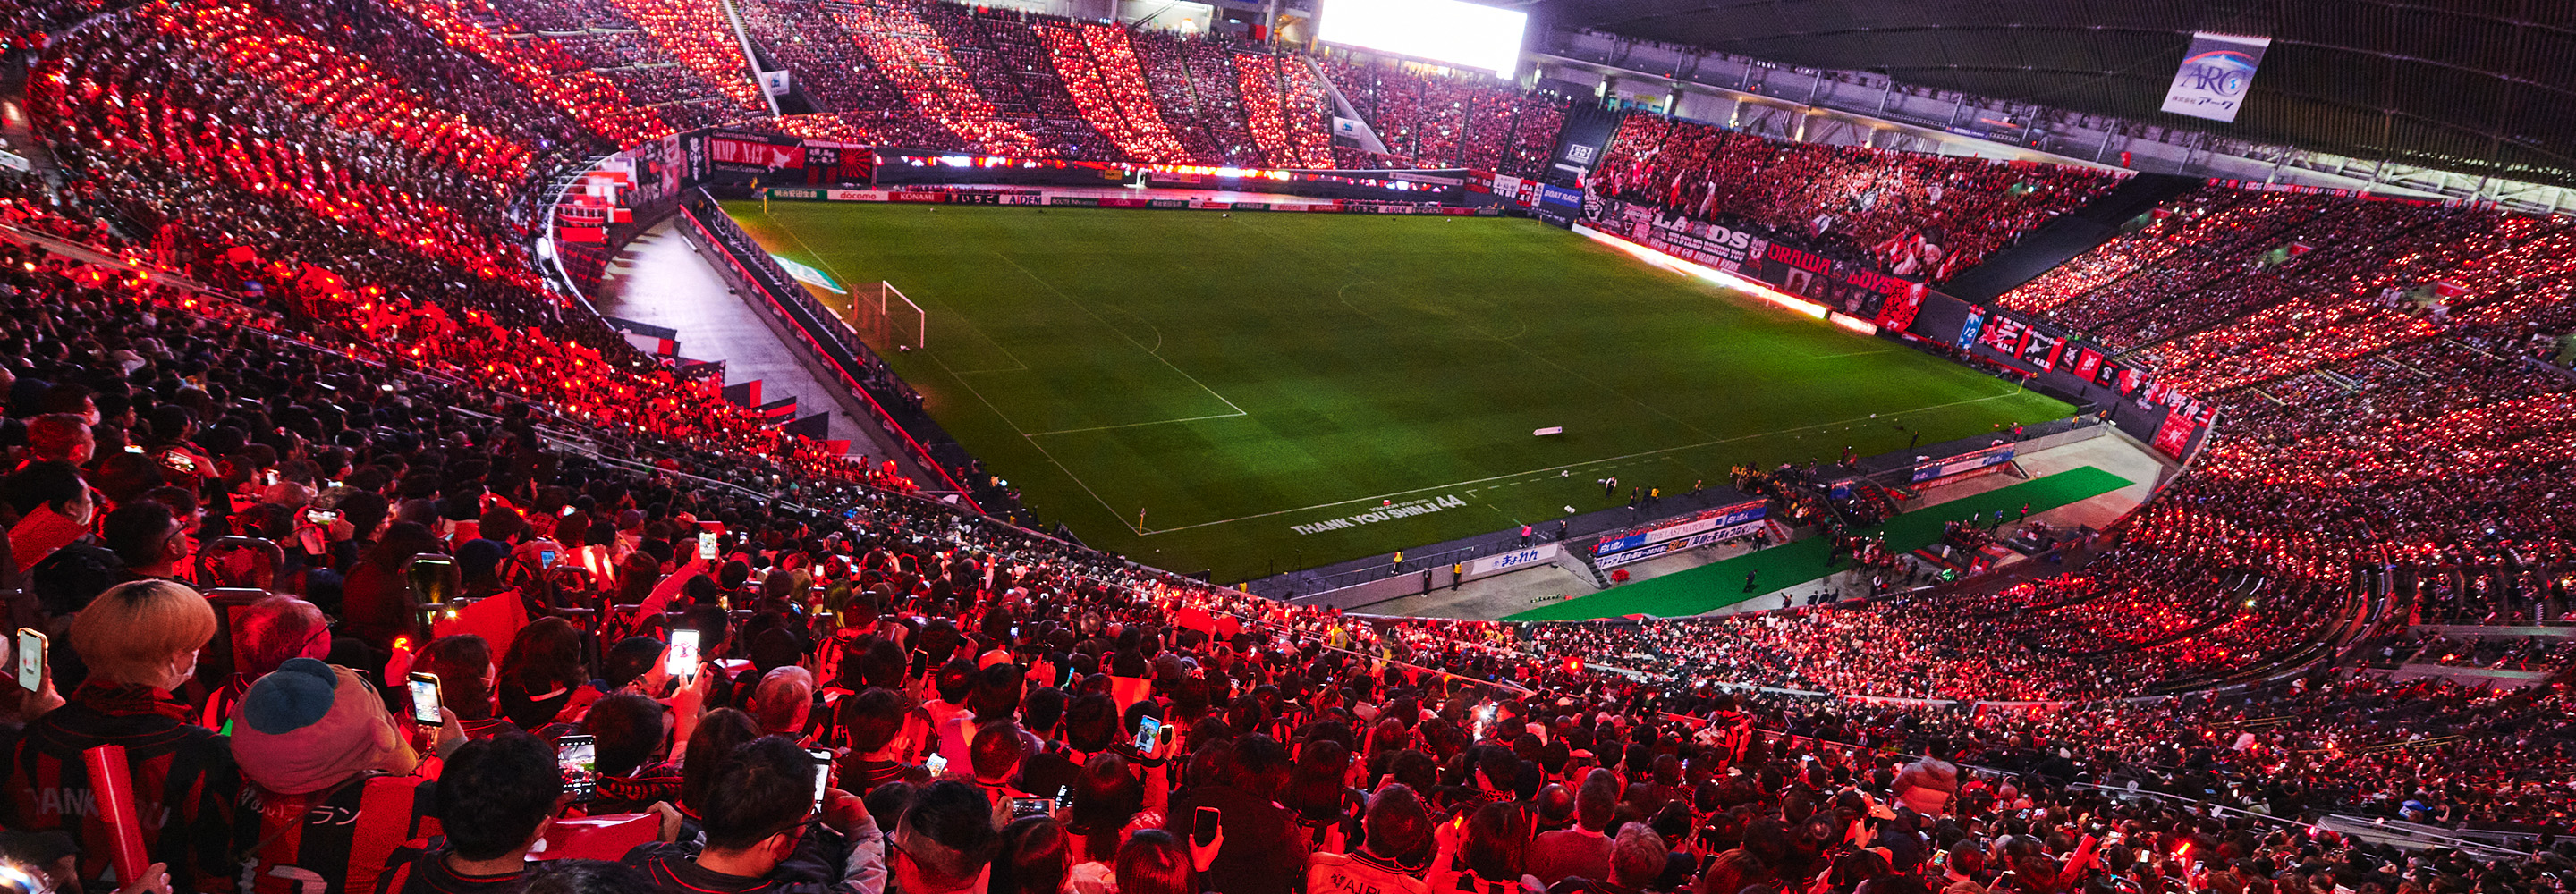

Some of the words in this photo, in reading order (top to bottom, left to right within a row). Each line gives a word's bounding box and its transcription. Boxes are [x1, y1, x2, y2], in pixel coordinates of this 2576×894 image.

[2178, 63, 2246, 97] ARC
[840, 191, 877, 200] docomo
[900, 191, 935, 201] KONAMI
[962, 194, 993, 204] いちご
[1009, 195, 1042, 205] AIDEM
[1544, 190, 1563, 199] BOAT
[1561, 193, 1580, 204] RACE
[1767, 242, 1831, 275] URAWA
[1963, 327, 1976, 338] 12
[2157, 387, 2210, 422] 小野伸二
[1290, 517, 1355, 536] THANK
[1348, 510, 1390, 526] YOU
[1386, 502, 1444, 519] SHINJI
[1436, 494, 1468, 509] 44
[1599, 540, 1625, 554] 白い恋人
